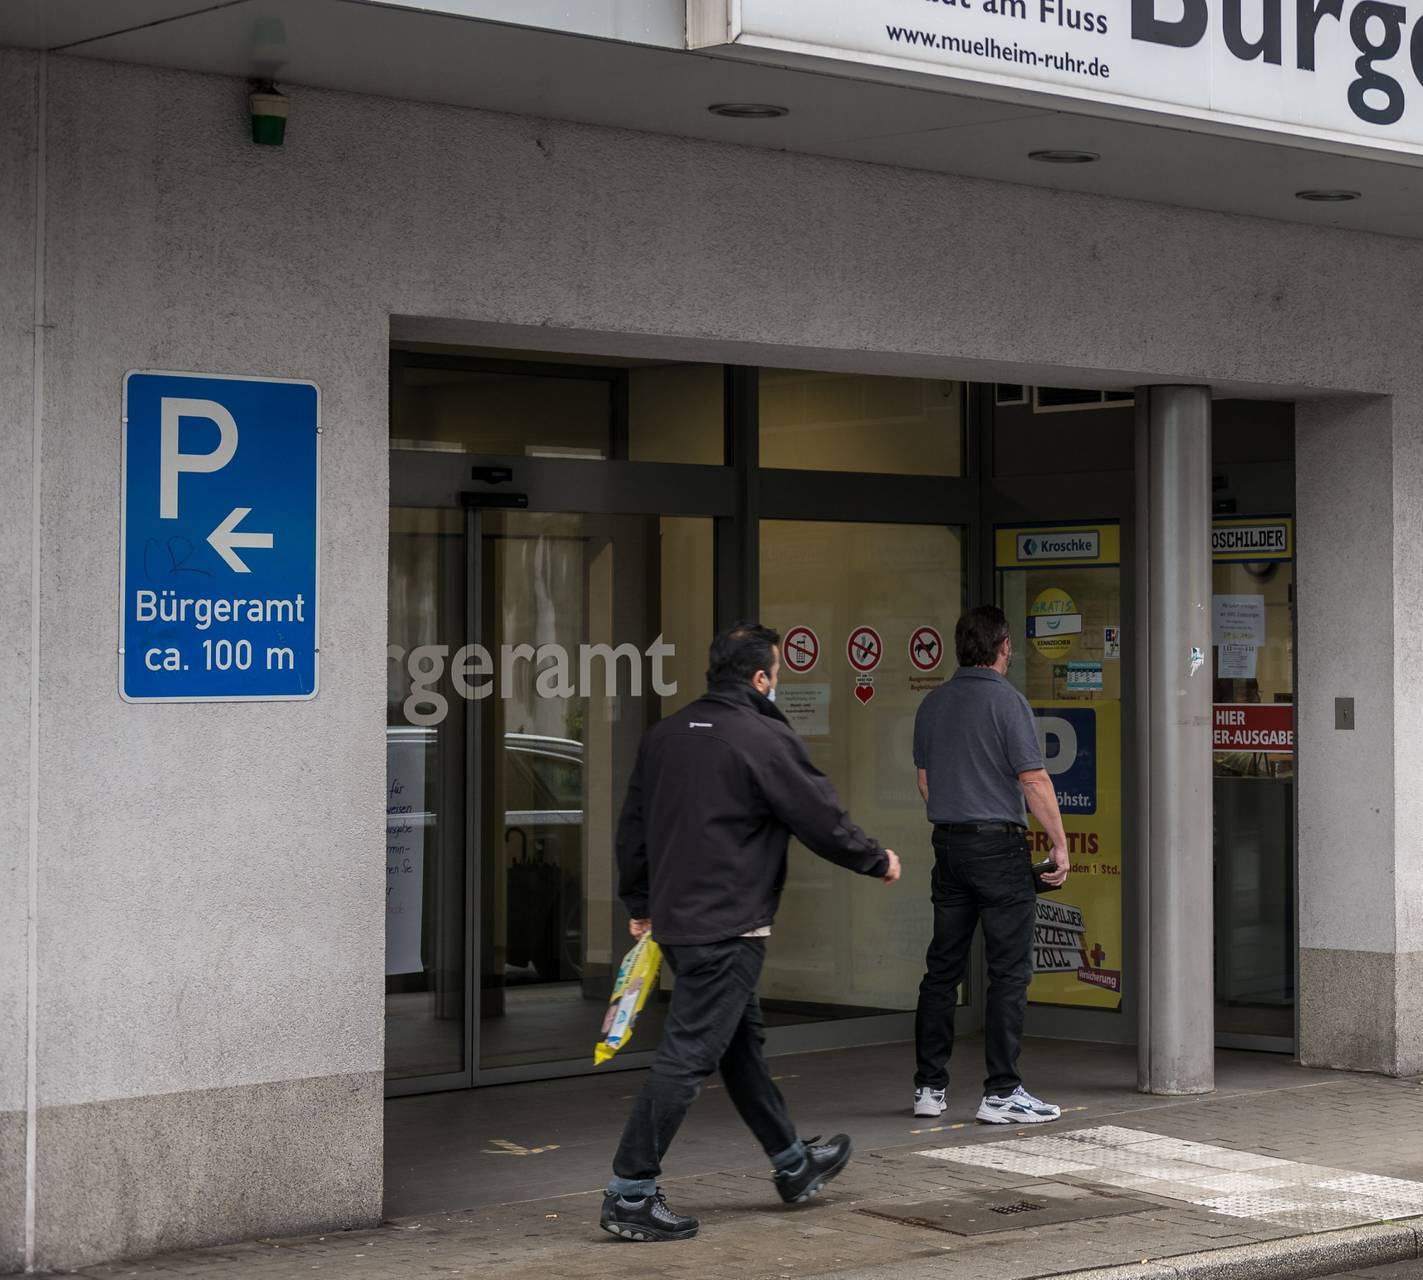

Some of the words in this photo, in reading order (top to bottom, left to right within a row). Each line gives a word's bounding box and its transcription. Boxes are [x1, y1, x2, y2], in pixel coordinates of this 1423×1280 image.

[1039, 0, 1108, 35] Fluss
[886, 24, 1110, 79] www.muelheim-ruhr.de
[160, 396, 239, 519] P
[1041, 539, 1092, 552] Kroschke
[136, 590, 305, 631] Bürgeramt
[145, 648, 189, 671] ca.
[202, 639, 252, 671] 100
[266, 646, 294, 670] m
[1216, 710, 1245, 725] HIER
[1101, 864, 1121, 875] Std.
[1035, 948, 1071, 969] ZOLL
[1079, 969, 1117, 988] Versicherung
